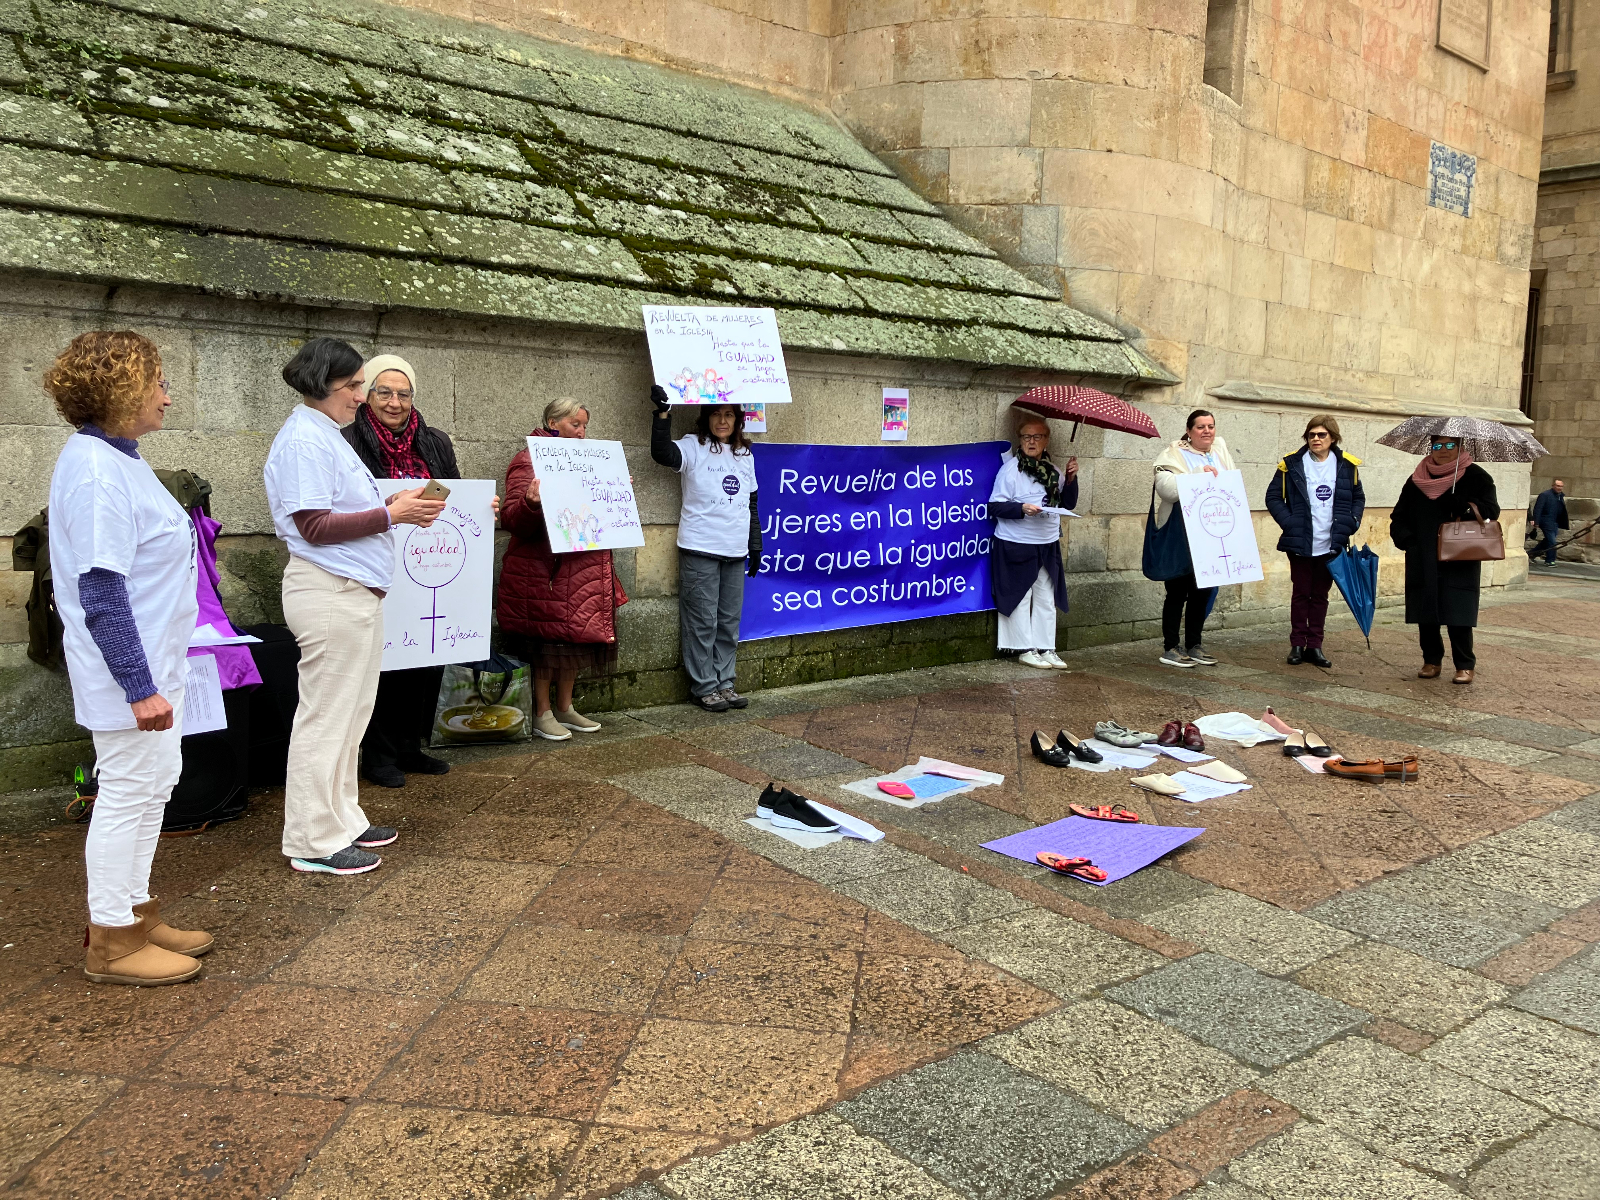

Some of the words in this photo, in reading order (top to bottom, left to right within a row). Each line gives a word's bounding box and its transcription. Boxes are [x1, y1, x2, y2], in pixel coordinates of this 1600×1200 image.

[648, 310, 701, 325] REVUELTA
[705, 314, 719, 322] DE
[721, 314, 764, 327] MUJERES
[654, 327, 665, 335] en
[666, 324, 676, 334] la
[680, 325, 714, 340] IGLESIA
[713, 337, 737, 350] Hasta
[741, 340, 755, 350] que
[758, 338, 770, 348] la
[718, 351, 775, 363] IGUALDAD
[754, 363, 775, 375] haga
[533, 442, 571, 460] REVUELTA
[572, 448, 581, 457] DE
[779, 468, 896, 494] Revuelta
[903, 465, 937, 489] de
[943, 464, 974, 487] las
[590, 487, 632, 504] IGUALDAD
[450, 506, 482, 537] mujeres
[760, 508, 842, 540] ujeres
[850, 510, 881, 530] en
[889, 503, 913, 527] la
[409, 537, 462, 564] igualdad
[815, 550, 871, 575] que
[879, 542, 903, 566] la
[910, 534, 994, 568] igualda
[771, 588, 823, 612] sea
[831, 574, 976, 606] costumbre.
[402, 631, 419, 647] la
[442, 626, 485, 647] Iglesia
